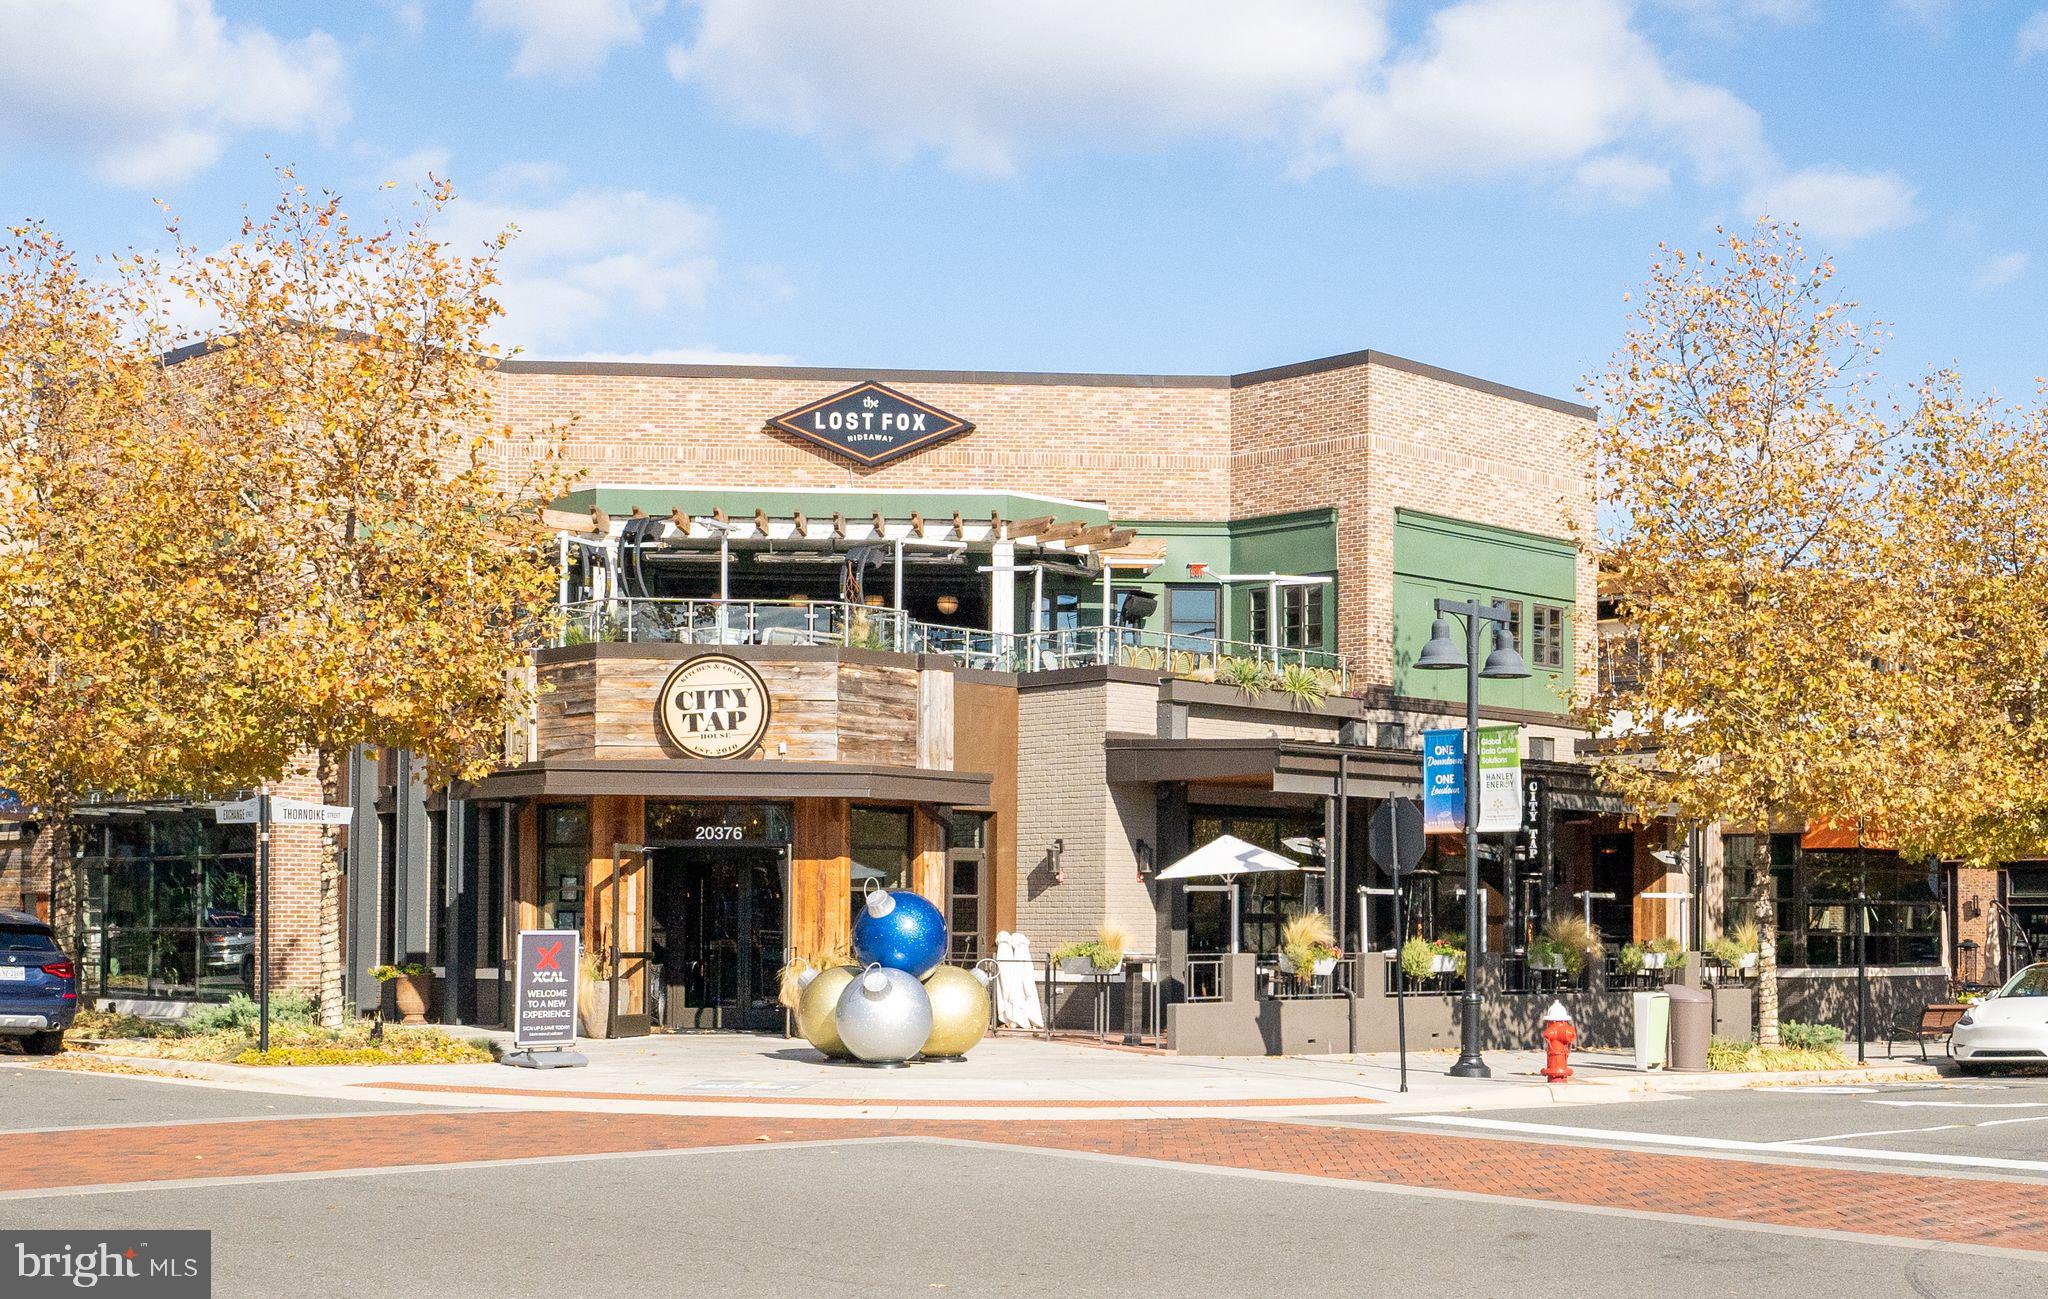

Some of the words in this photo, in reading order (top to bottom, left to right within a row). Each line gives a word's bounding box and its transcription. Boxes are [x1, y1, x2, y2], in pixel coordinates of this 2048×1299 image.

[863, 396, 879, 410] the
[815, 412, 873, 430] LOST
[881, 413, 926, 431] FOX
[847, 433, 894, 442] HIDEAWAY
[680, 664, 713, 683] KITCHEN
[722, 666, 745, 680] CRAFT
[675, 688, 752, 711] CITY
[682, 711, 747, 733] TAP
[700, 732, 731, 740] HOUSE
[1481, 737, 1501, 746] Global
[716, 744, 738, 754] 2010
[1434, 745, 1454, 755] ONE
[1497, 746, 1517, 754] Center
[1427, 756, 1463, 766] Downtown
[1435, 774, 1455, 784] ONE
[1486, 772, 1514, 780] HANLEY
[1528, 781, 1538, 821] CITY
[283, 809, 326, 820] THORNDIKE
[696, 826, 743, 840] 20376
[1528, 829, 1538, 859] TAP
[532, 971, 568, 983] XCAL
[527, 989, 568, 998] WELCOME
[528, 1000, 539, 1008] TO
[540, 1000, 547, 1008] A
[548, 999, 567, 1008] NEW
[523, 1010, 571, 1019] EXPERIENCE
